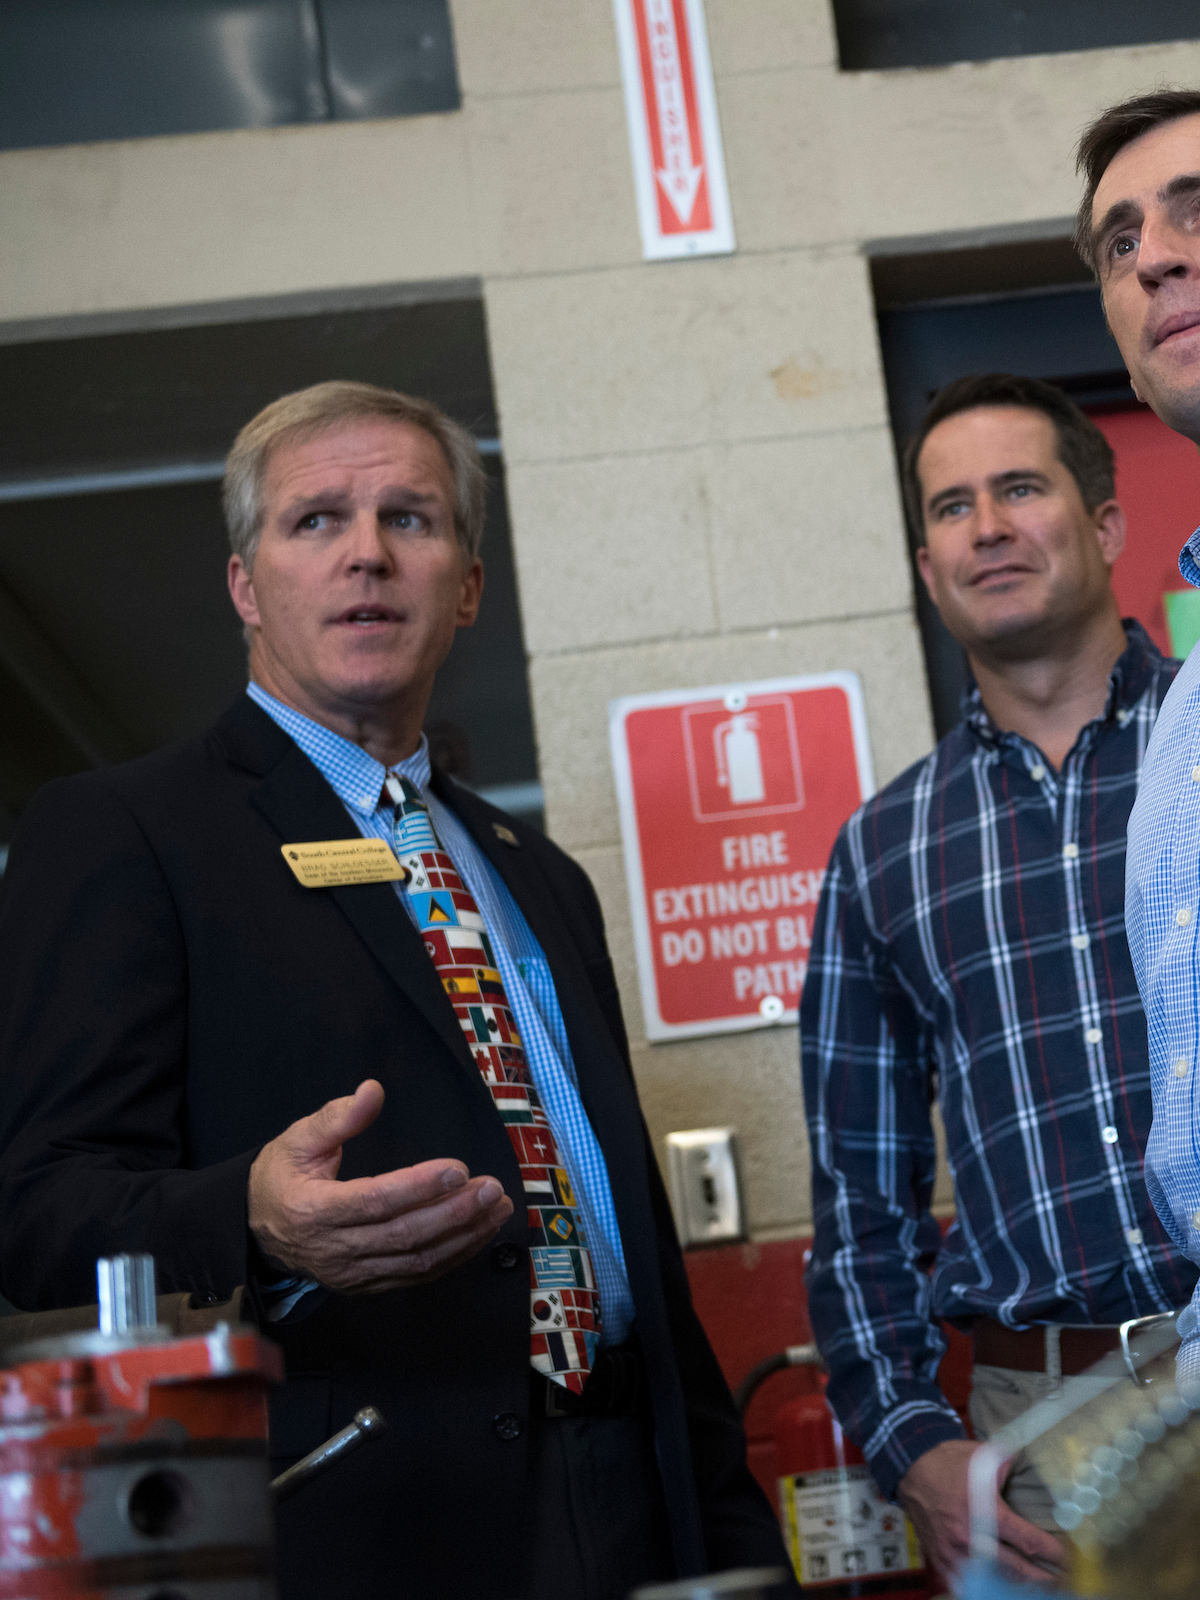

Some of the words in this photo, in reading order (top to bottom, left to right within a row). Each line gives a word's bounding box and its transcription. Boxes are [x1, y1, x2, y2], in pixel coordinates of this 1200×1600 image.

[653, 0, 688, 192] INGUISHER
[722, 830, 789, 871] FIRE
[653, 868, 826, 923] EXTINGUISH
[661, 928, 704, 967] DO
[710, 918, 768, 960] NOT
[776, 914, 811, 951] BL
[734, 958, 808, 1001] PATH
